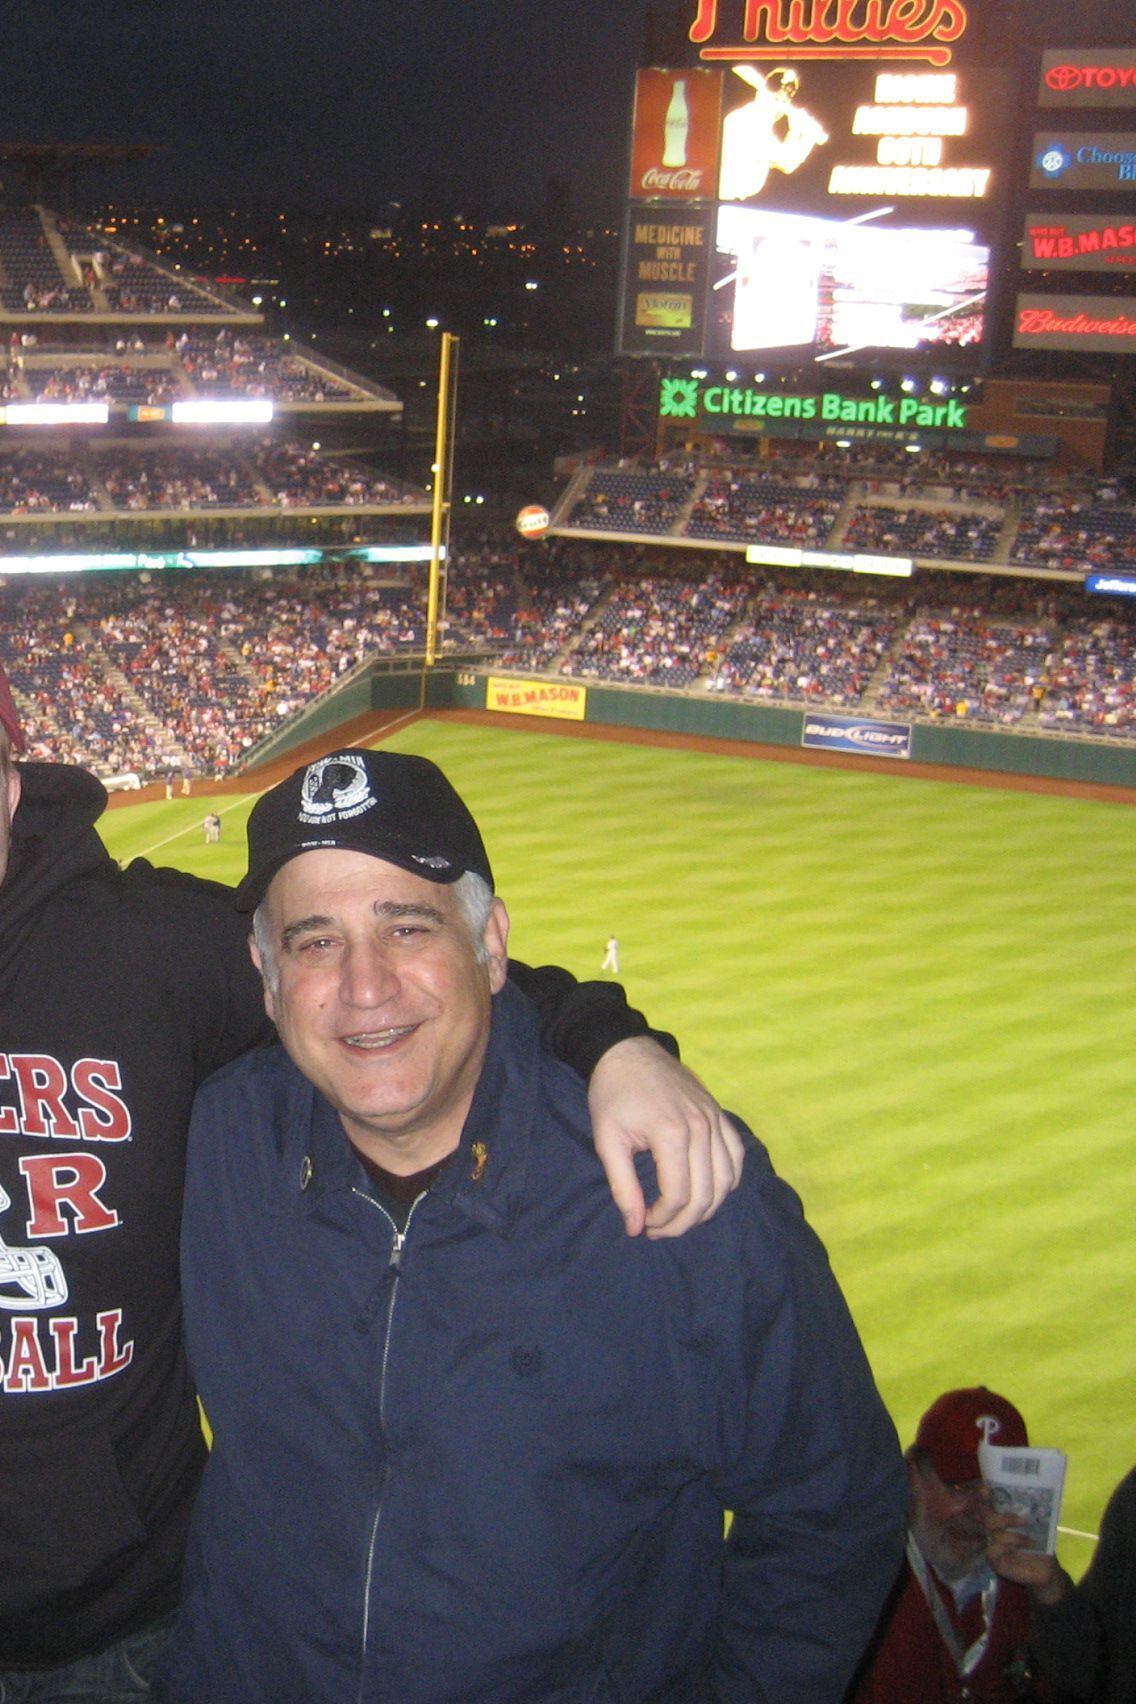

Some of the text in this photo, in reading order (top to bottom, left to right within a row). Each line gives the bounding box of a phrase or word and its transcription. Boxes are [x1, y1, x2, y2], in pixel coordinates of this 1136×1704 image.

[1080, 66, 1136, 88] TOY
[641, 168, 703, 190] Coca-Cola
[634, 224, 704, 246] MEDICINE
[638, 261, 696, 282] MUSCLE
[702, 386, 965, 428] Citizens Bank Park
[805, 724, 908, 745] BUD LIGHT
[321, 813, 336, 824] NOT
[19, 1152, 119, 1239] R
[975, 1415, 1000, 1445] P
